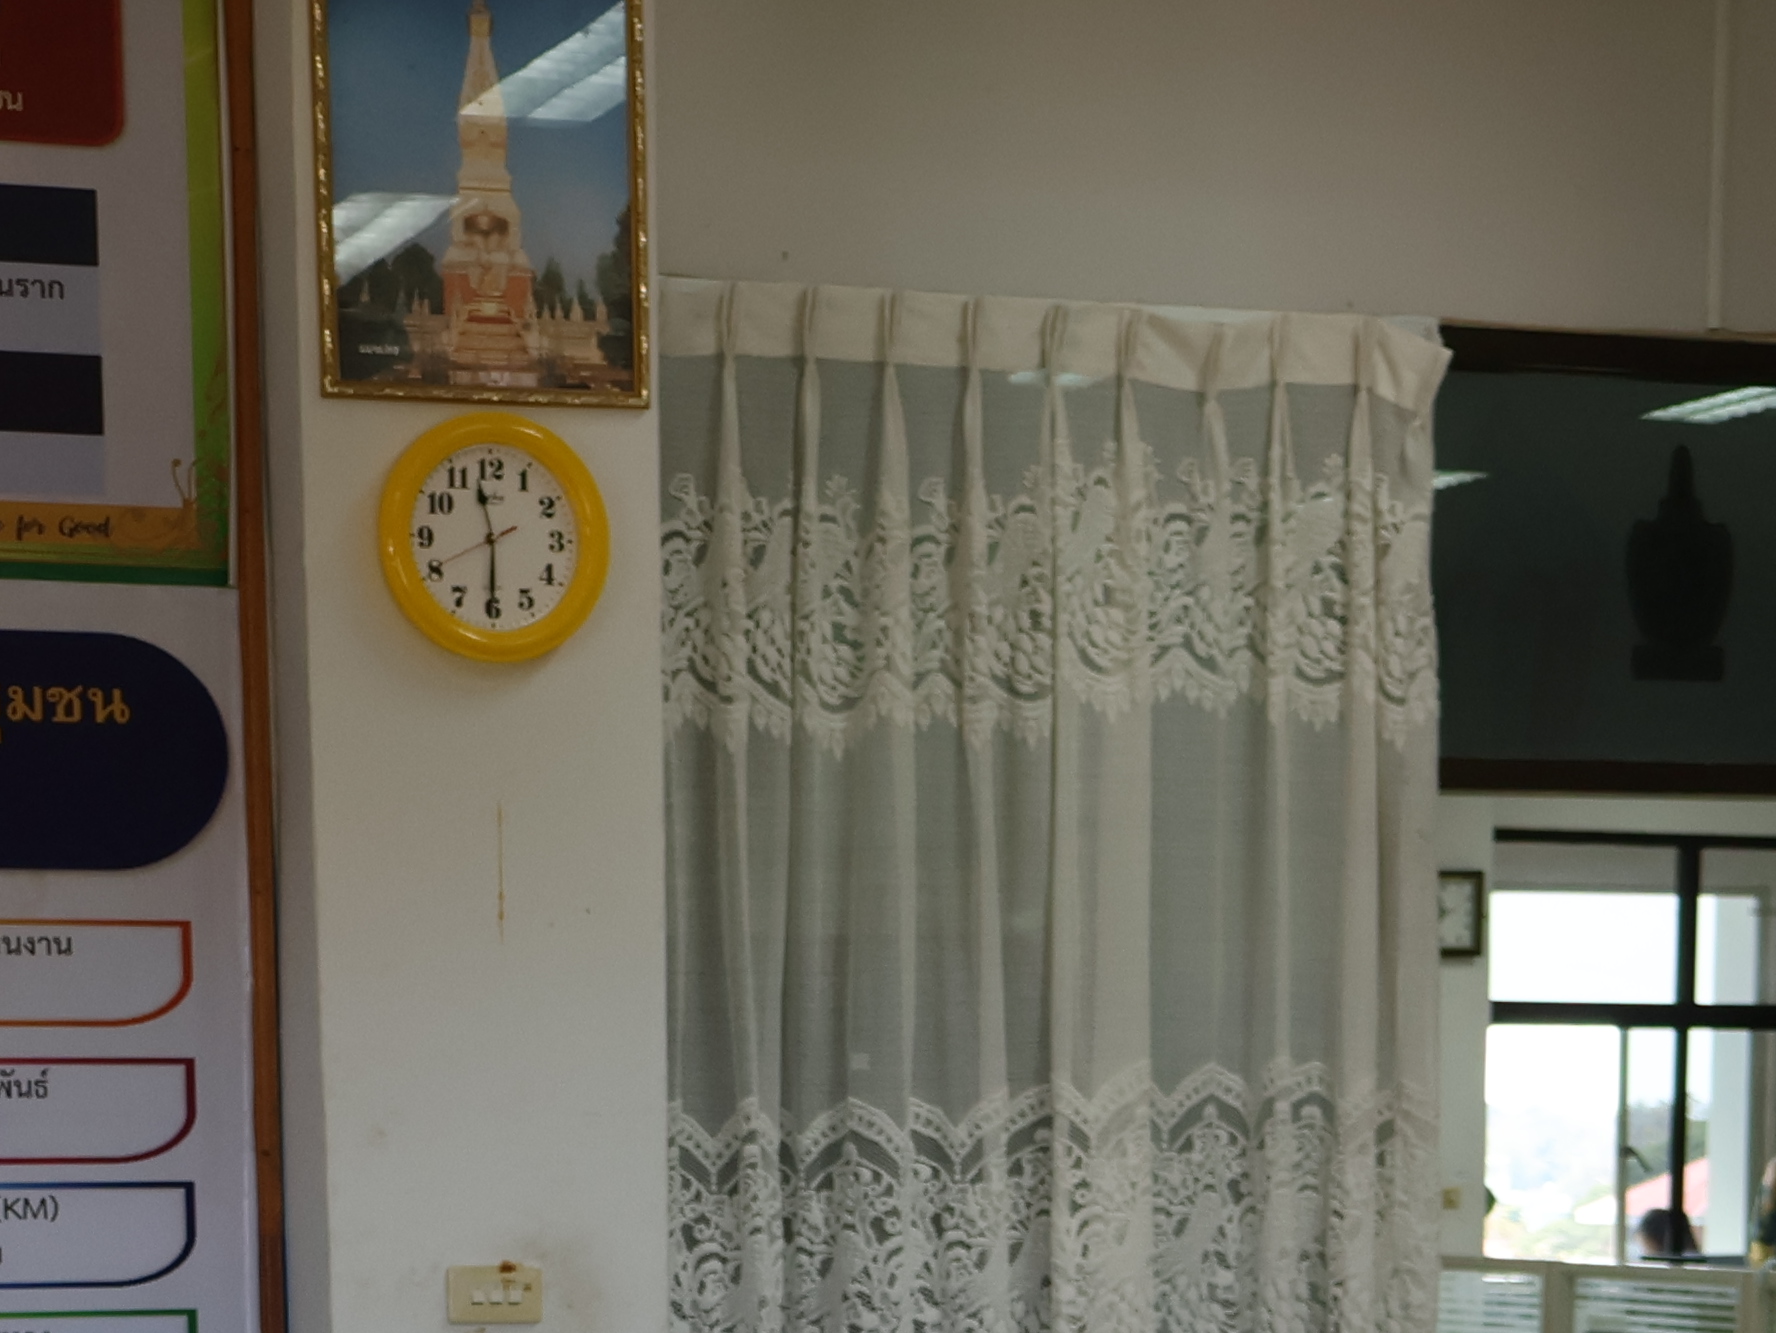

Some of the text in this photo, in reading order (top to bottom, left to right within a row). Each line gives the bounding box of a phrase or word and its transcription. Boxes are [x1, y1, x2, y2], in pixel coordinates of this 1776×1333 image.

[447, 466, 470, 490] 11
[477, 458, 505, 482] 12
[518, 468, 530, 492] 1
[427, 491, 454, 515] 10
[538, 496, 556, 519] 2
[417, 526, 434, 549] 9
[548, 530, 565, 553] 3
[427, 559, 444, 582] 8
[539, 563, 557, 586] 4
[451, 585, 468, 608] 7
[518, 588, 535, 610] 5
[484, 597, 502, 620] 6
